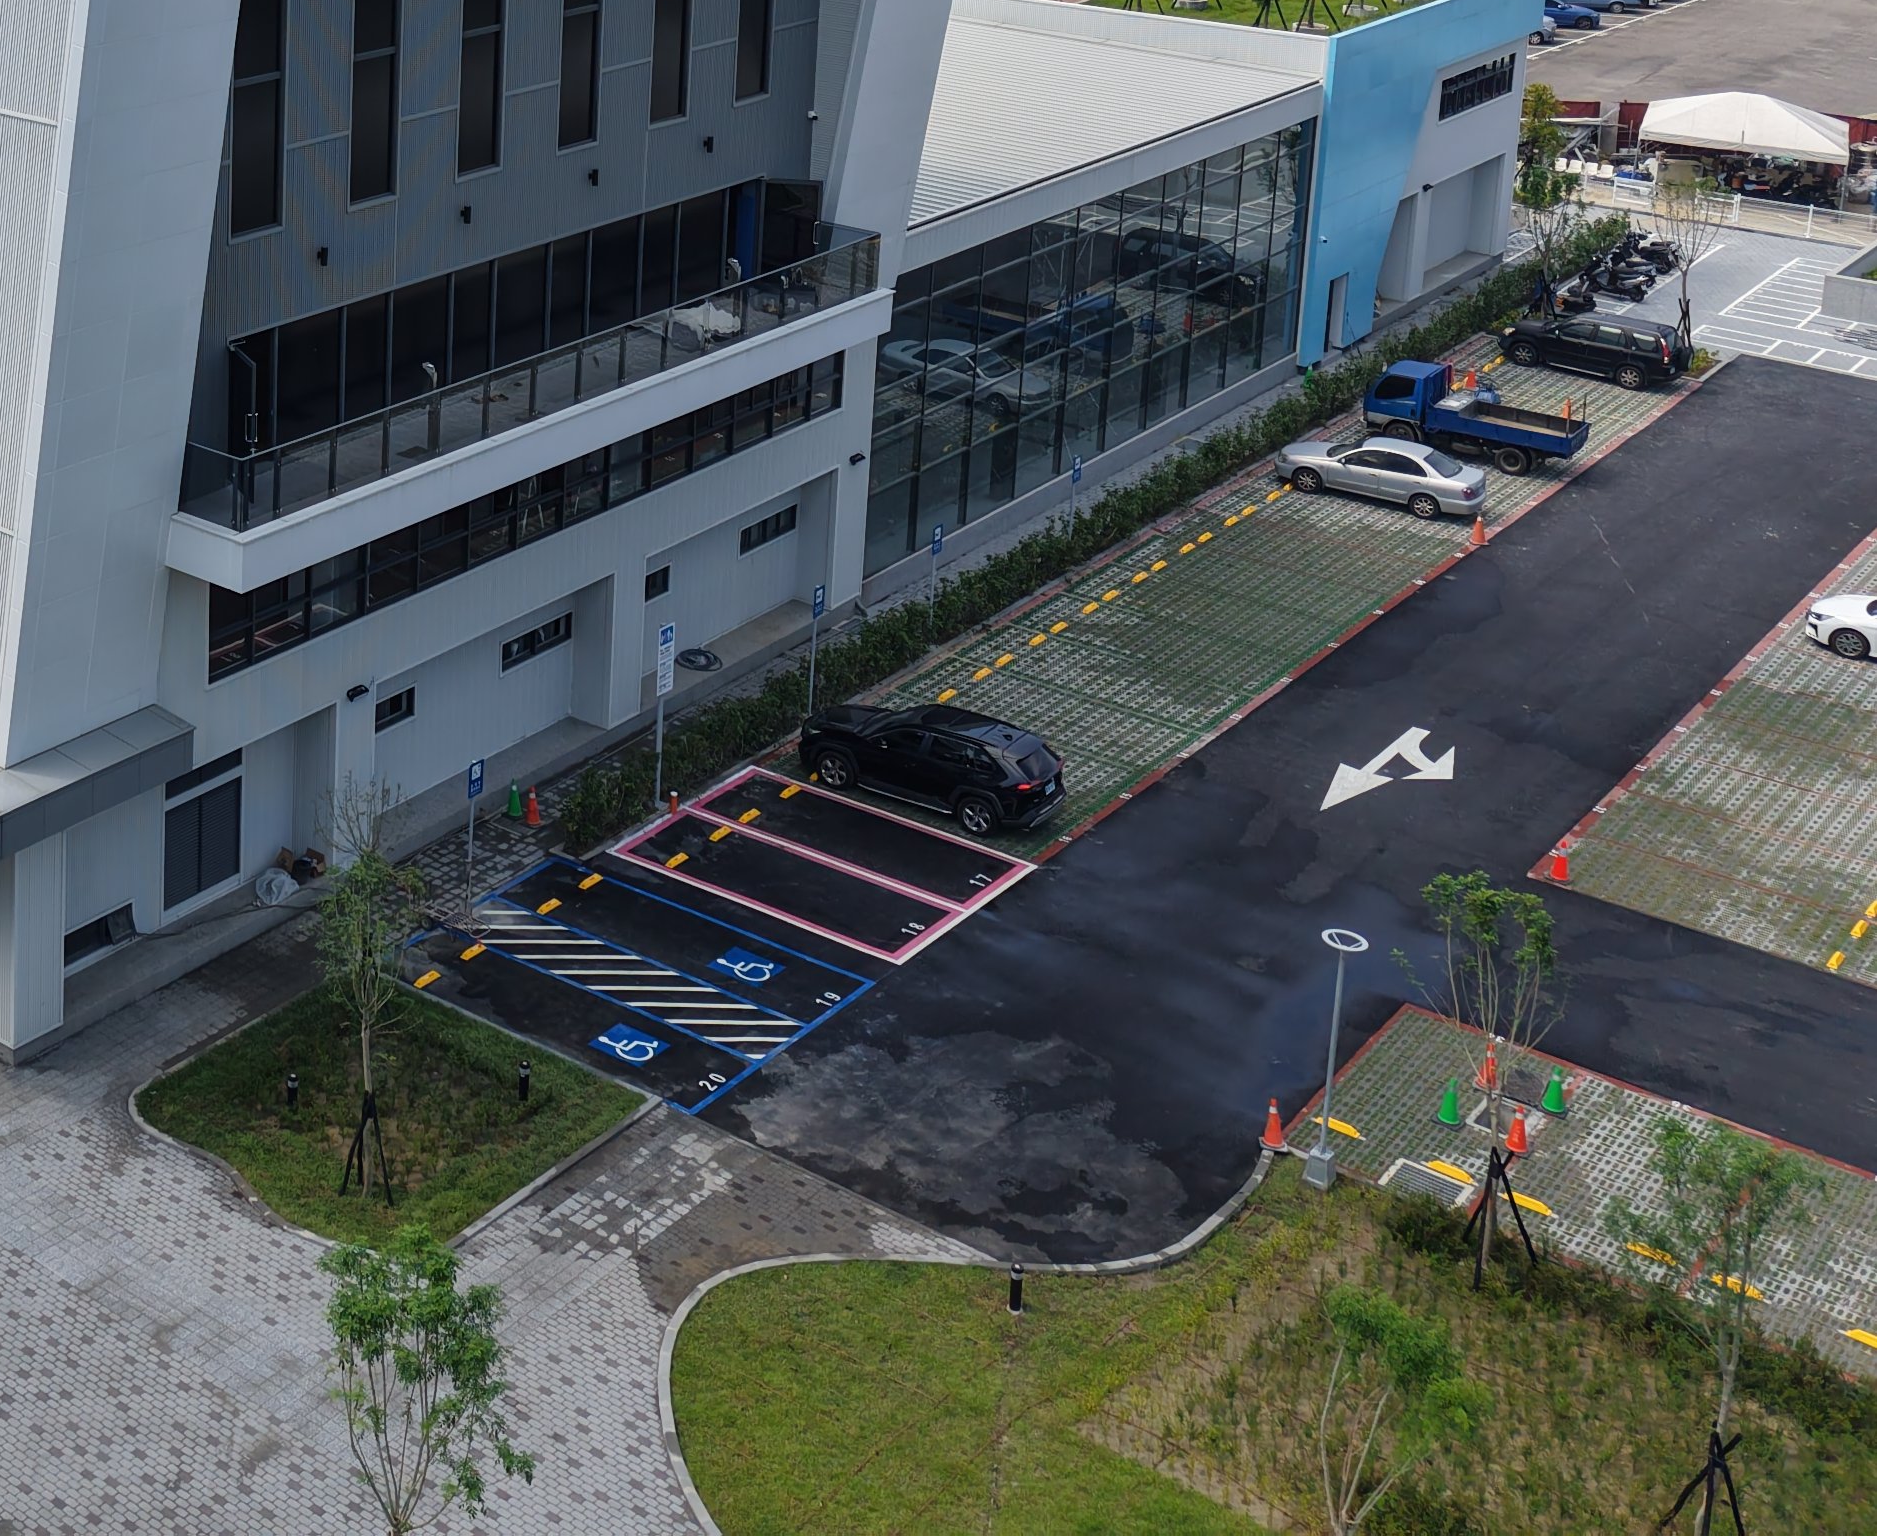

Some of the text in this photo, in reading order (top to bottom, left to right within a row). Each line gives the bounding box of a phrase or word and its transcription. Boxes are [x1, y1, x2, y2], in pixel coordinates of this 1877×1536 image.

[969, 872, 993, 888] 17
[901, 921, 925, 937] 18
[815, 990, 841, 1008] 19
[698, 1072, 727, 1092] 20
